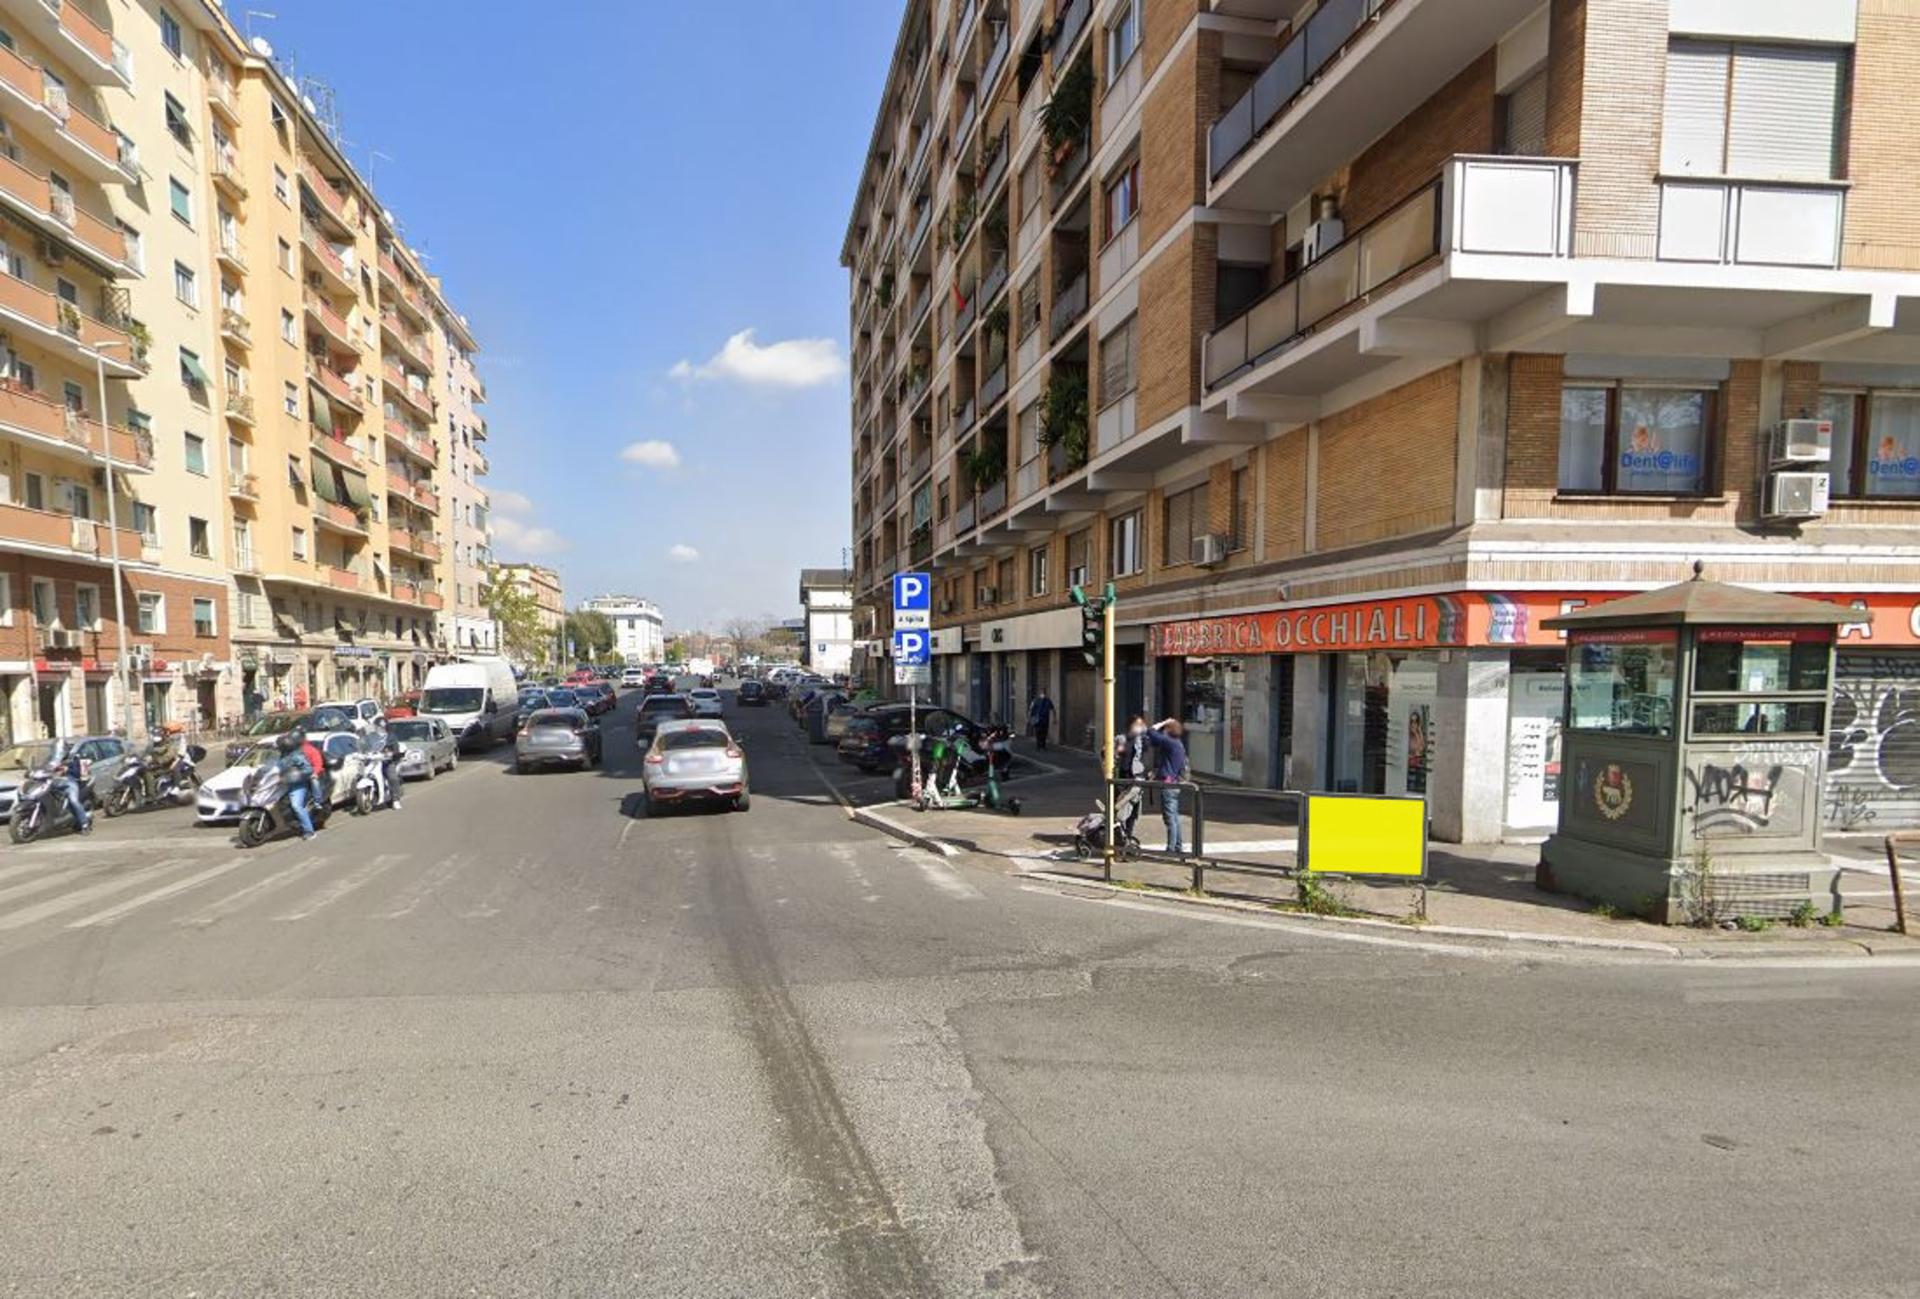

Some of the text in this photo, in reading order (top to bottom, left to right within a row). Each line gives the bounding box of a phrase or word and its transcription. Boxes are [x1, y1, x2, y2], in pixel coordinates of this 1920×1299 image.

[901, 578, 922, 607] P
[1164, 619, 1262, 650] FABBRICA
[1276, 605, 1426, 646] OCCHIALI
[901, 633, 922, 662] P
